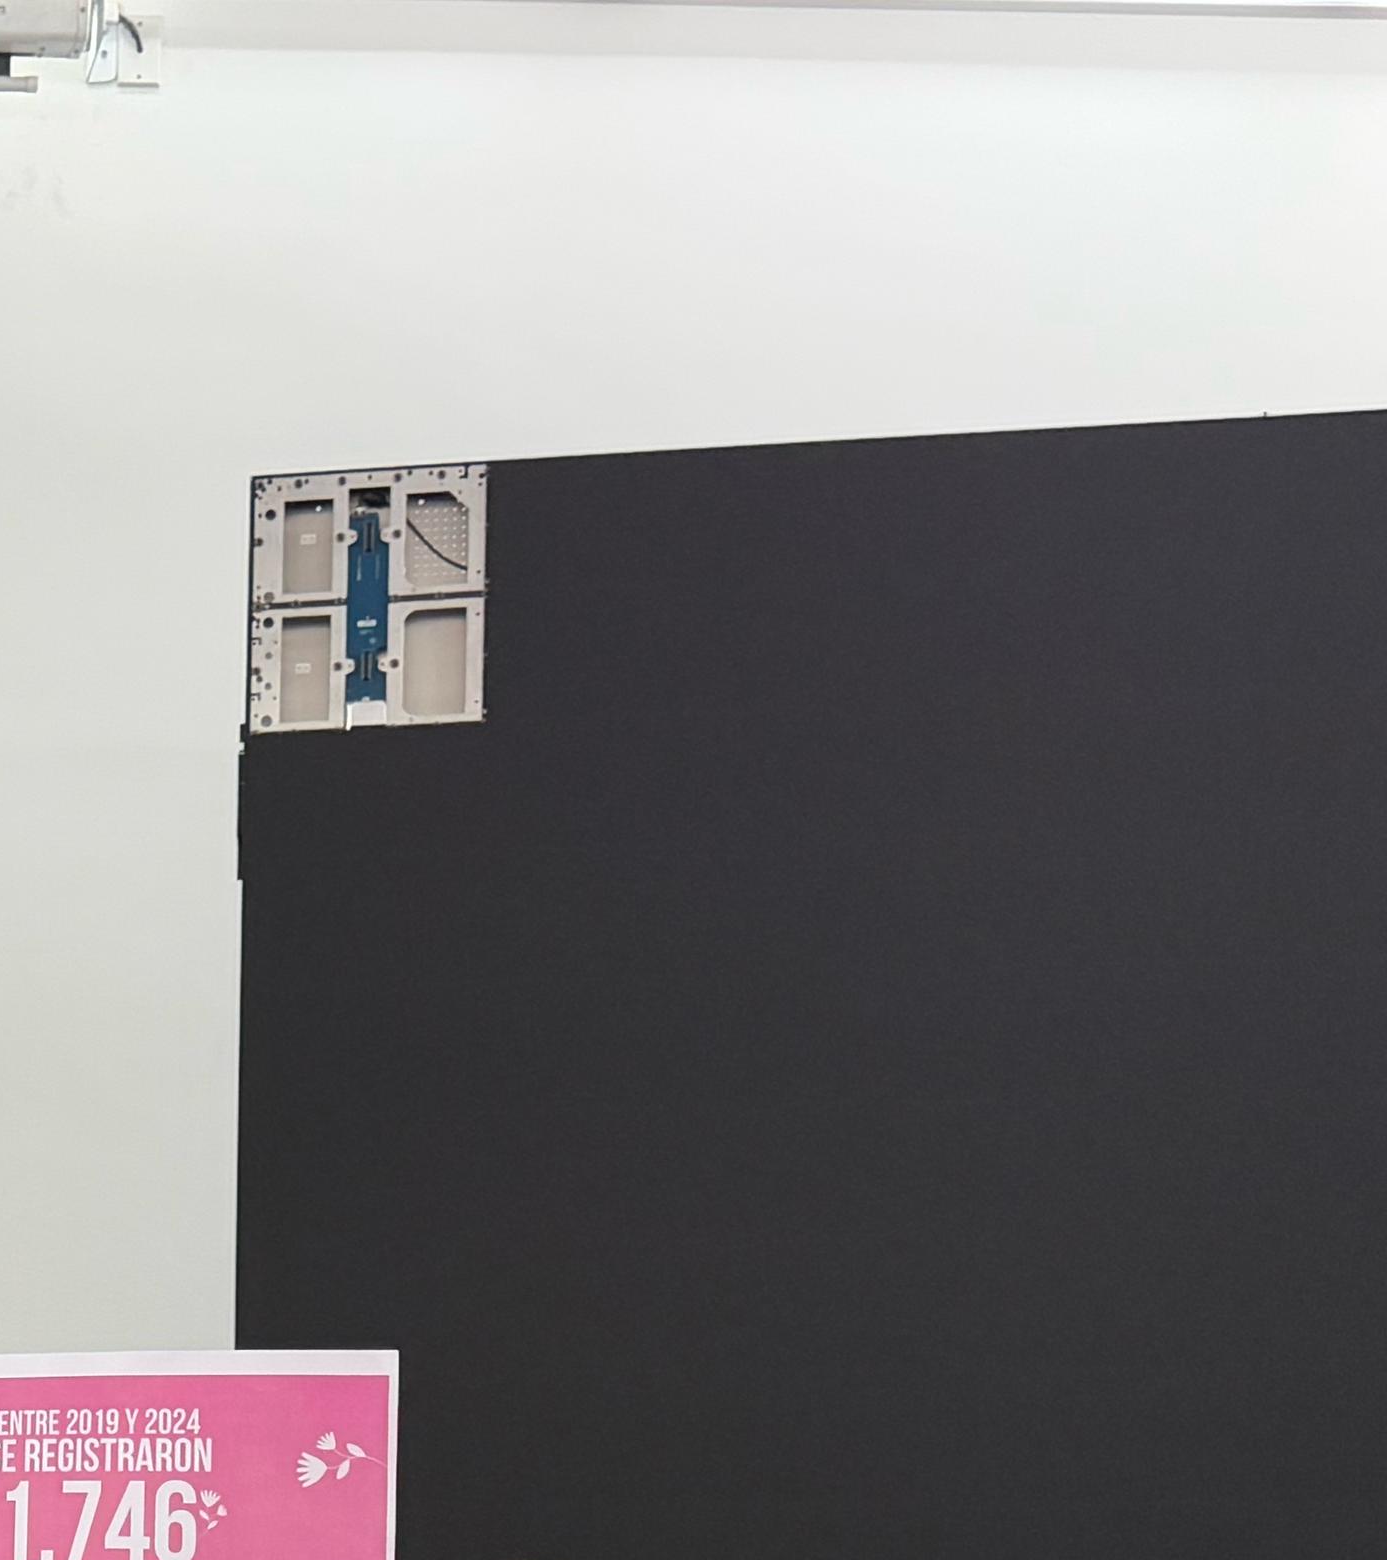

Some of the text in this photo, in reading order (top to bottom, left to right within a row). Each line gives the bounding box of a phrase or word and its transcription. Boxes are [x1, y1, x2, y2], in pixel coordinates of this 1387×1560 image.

[66, 1410, 119, 1435] 2019
[127, 1409, 141, 1434] Y
[144, 1408, 201, 1434] 2024
[23, 1438, 212, 1473] REGISTRARON
